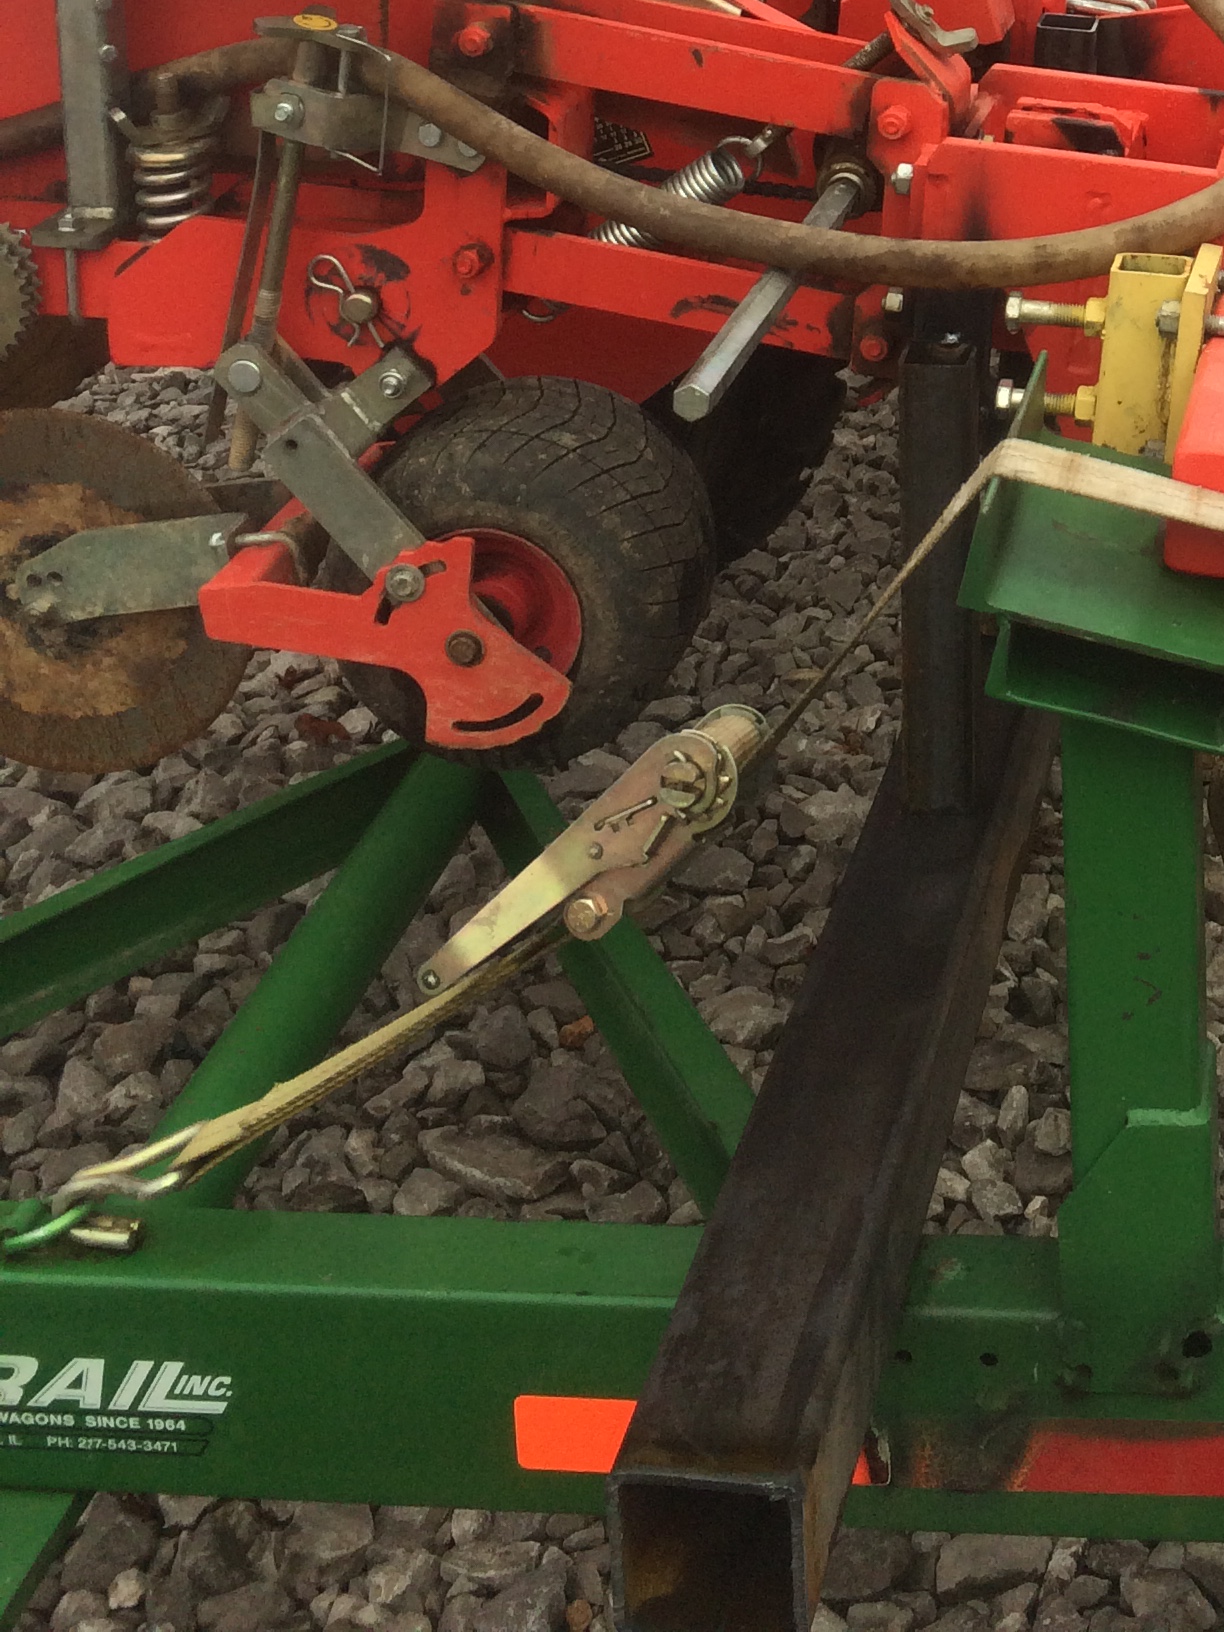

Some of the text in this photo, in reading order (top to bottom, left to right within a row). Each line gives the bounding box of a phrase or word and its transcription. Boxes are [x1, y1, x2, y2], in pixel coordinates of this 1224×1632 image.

[174, 1374, 233, 1397] INC.
[85, 1415, 141, 1429] SINCE
[146, 1418, 186, 1431] 1964
[77, 1436, 178, 1452] 217-543-3471
